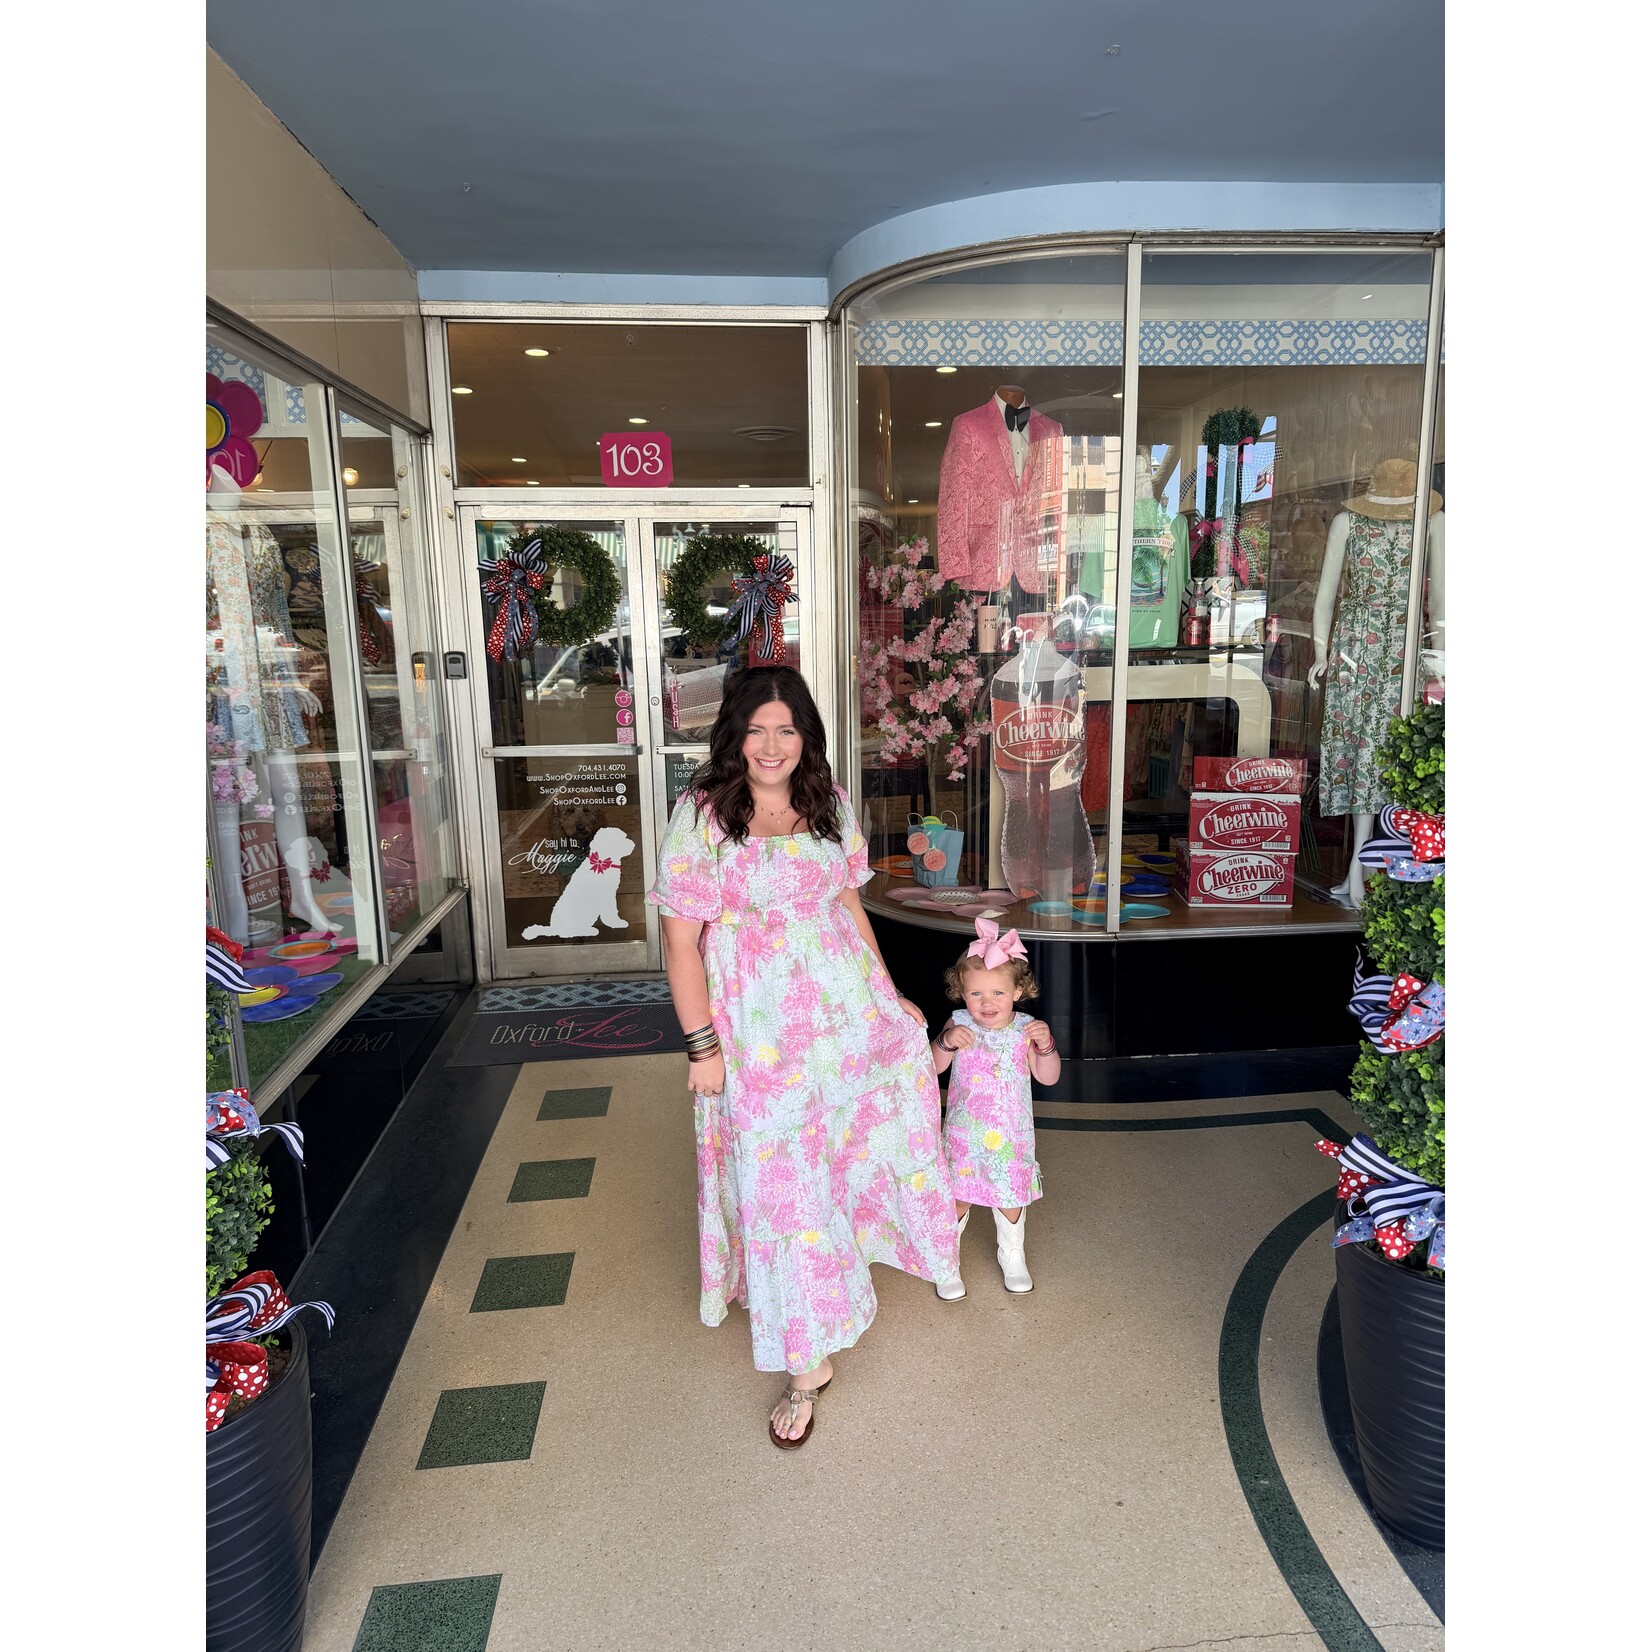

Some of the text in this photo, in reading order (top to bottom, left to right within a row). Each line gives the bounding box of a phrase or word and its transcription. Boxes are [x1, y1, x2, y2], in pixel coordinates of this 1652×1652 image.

[606, 442, 664, 477] 103
[670, 679, 680, 728] PUSH
[1028, 710, 1053, 720] DRINK
[995, 719, 1086, 749] Cheerwine
[1024, 748, 1060, 758] SINCE 1917
[578, 763, 626, 772] 704.431.4070
[673, 762, 700, 771] TUESDA
[1225, 762, 1293, 787] Cheerwine
[1229, 803, 1252, 812] DRINK
[1199, 807, 1288, 839] Cheerwine
[240, 828, 259, 842] INK
[545, 839, 558, 849] say
[560, 837, 568, 847] hi
[508, 838, 577, 874] Maggie
[1228, 857, 1249, 866] DRINK
[1198, 860, 1284, 893] Cheerwine
[1227, 883, 1257, 895] ZERO
[246, 890, 268, 906] INCE
[490, 1007, 664, 1049] Oxford Lee
